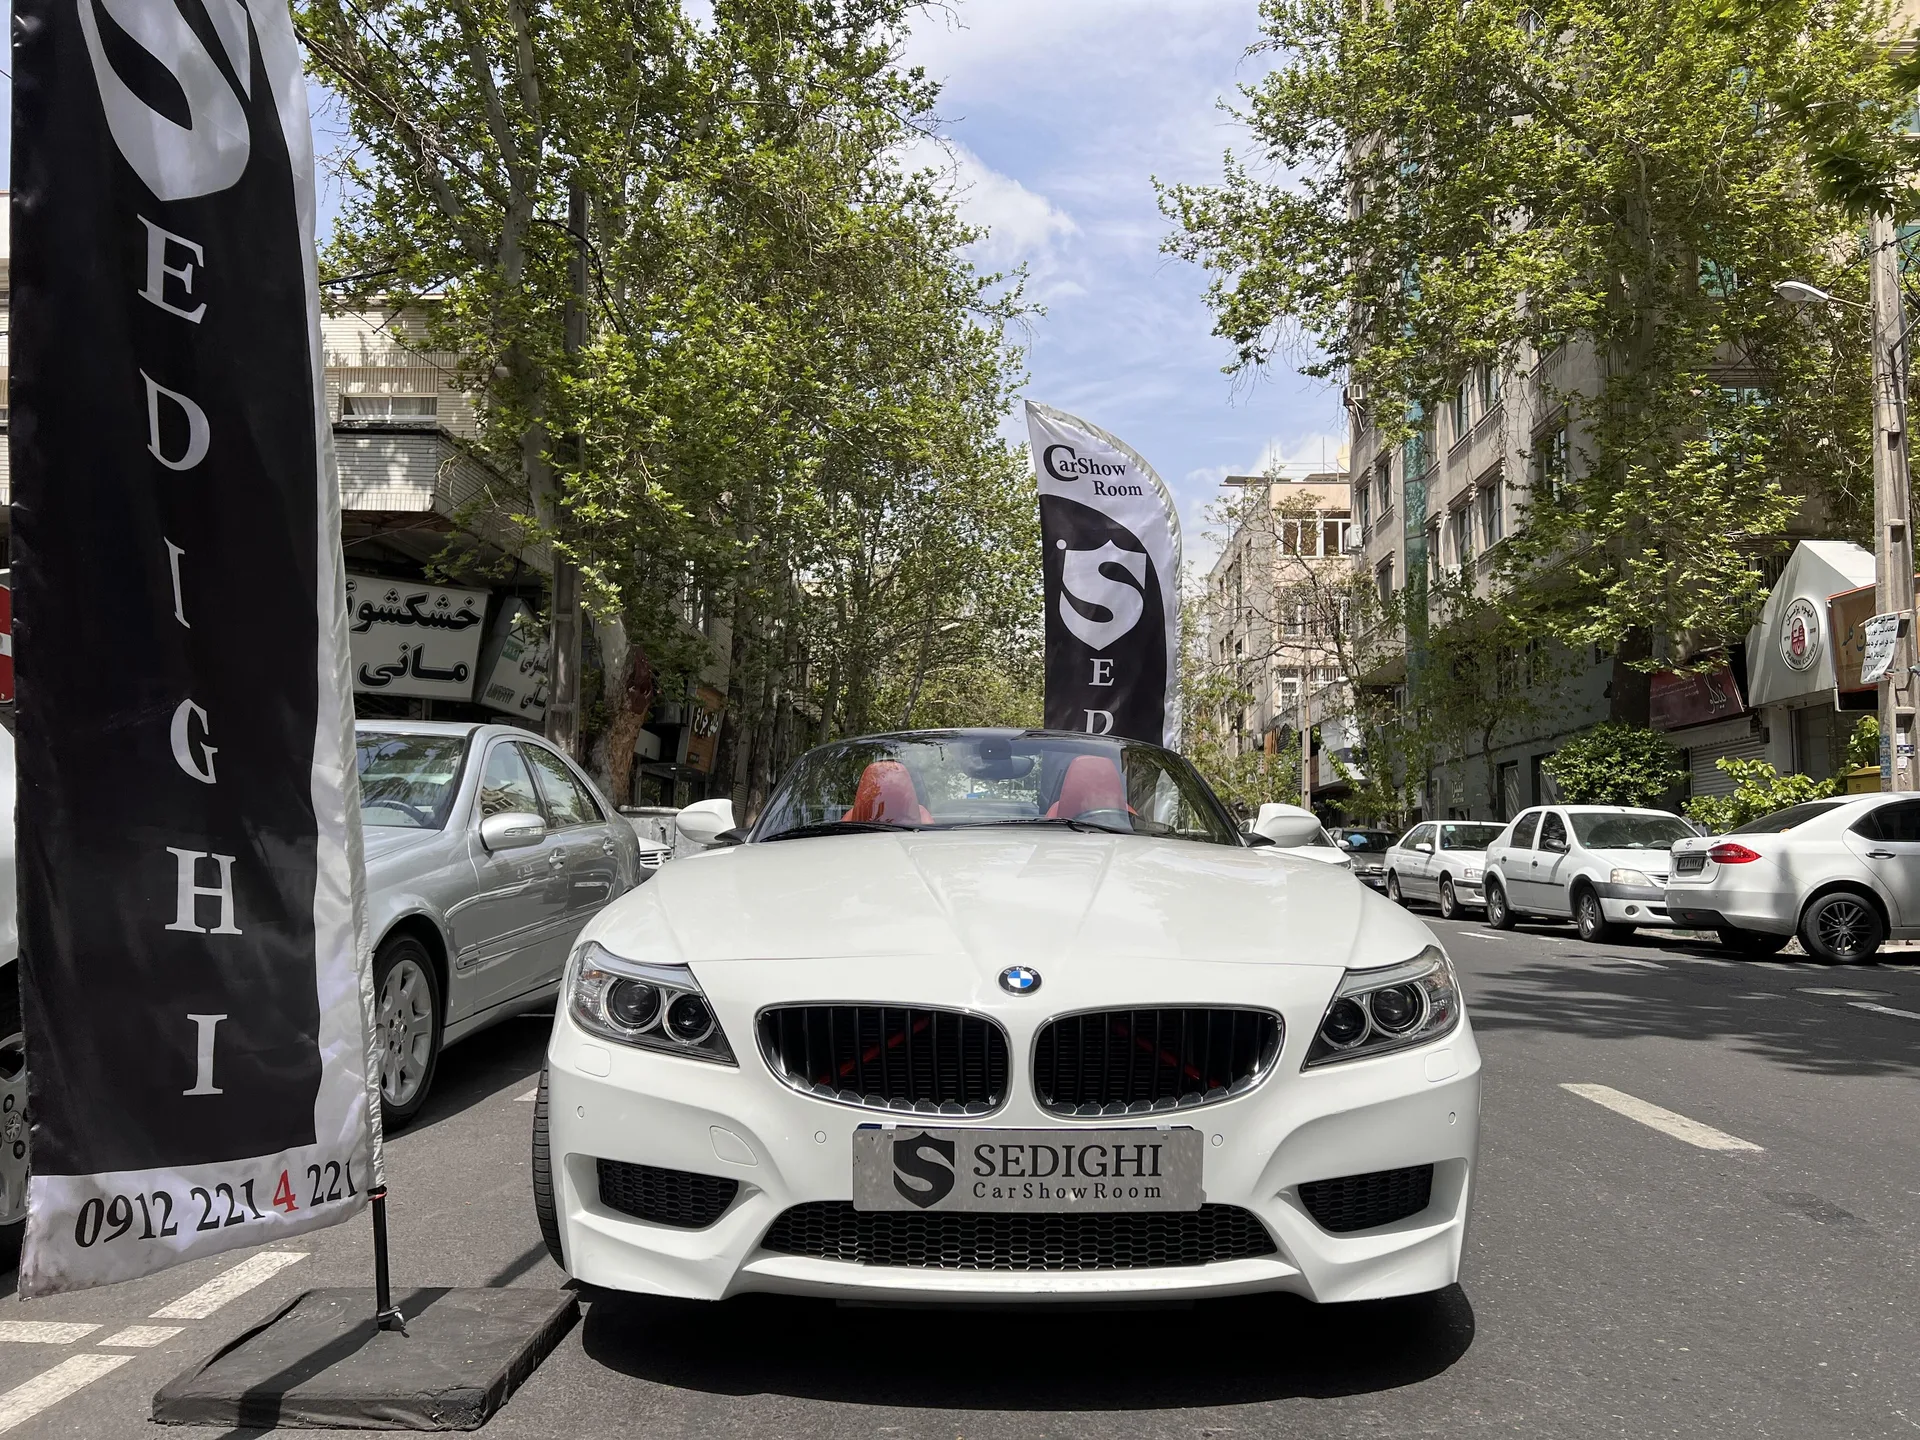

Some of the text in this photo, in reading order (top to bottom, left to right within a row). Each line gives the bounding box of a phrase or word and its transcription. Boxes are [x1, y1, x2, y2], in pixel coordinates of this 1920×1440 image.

[1043, 444, 1126, 482] CarShow
[1094, 480, 1143, 497] Room
[358, 642, 470, 687] مانی
[973, 1144, 1163, 1177] SEDIGHI
[75, 1159, 358, 1248] 0912 221 4 221
